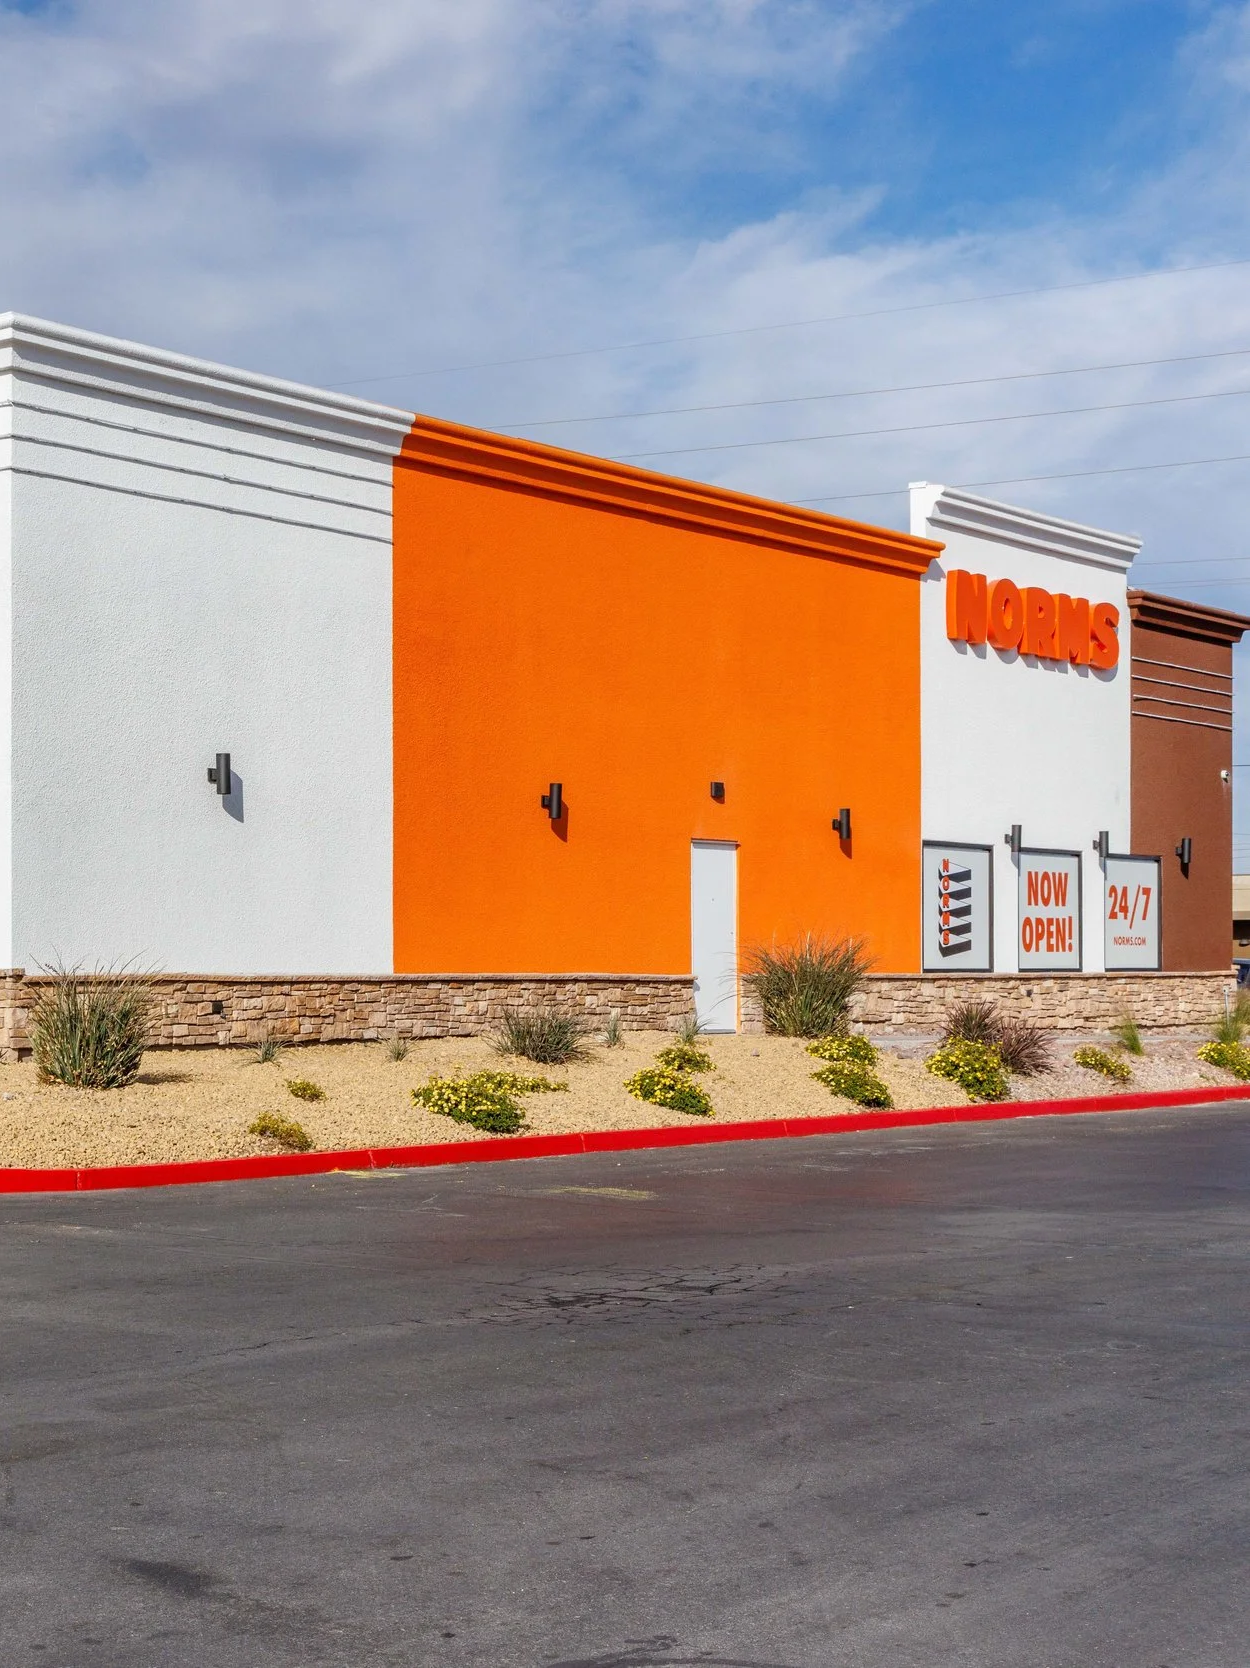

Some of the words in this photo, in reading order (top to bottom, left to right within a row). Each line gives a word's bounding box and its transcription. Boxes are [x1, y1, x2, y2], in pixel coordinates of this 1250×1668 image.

[945, 569, 1120, 670] NORMS
[942, 858, 950, 946] NORMS
[1027, 870, 1069, 907] NOW
[1108, 884, 1152, 930] 24/7
[1021, 915, 1073, 953] OPEN!
[1113, 936, 1147, 947] NORMS.COM
